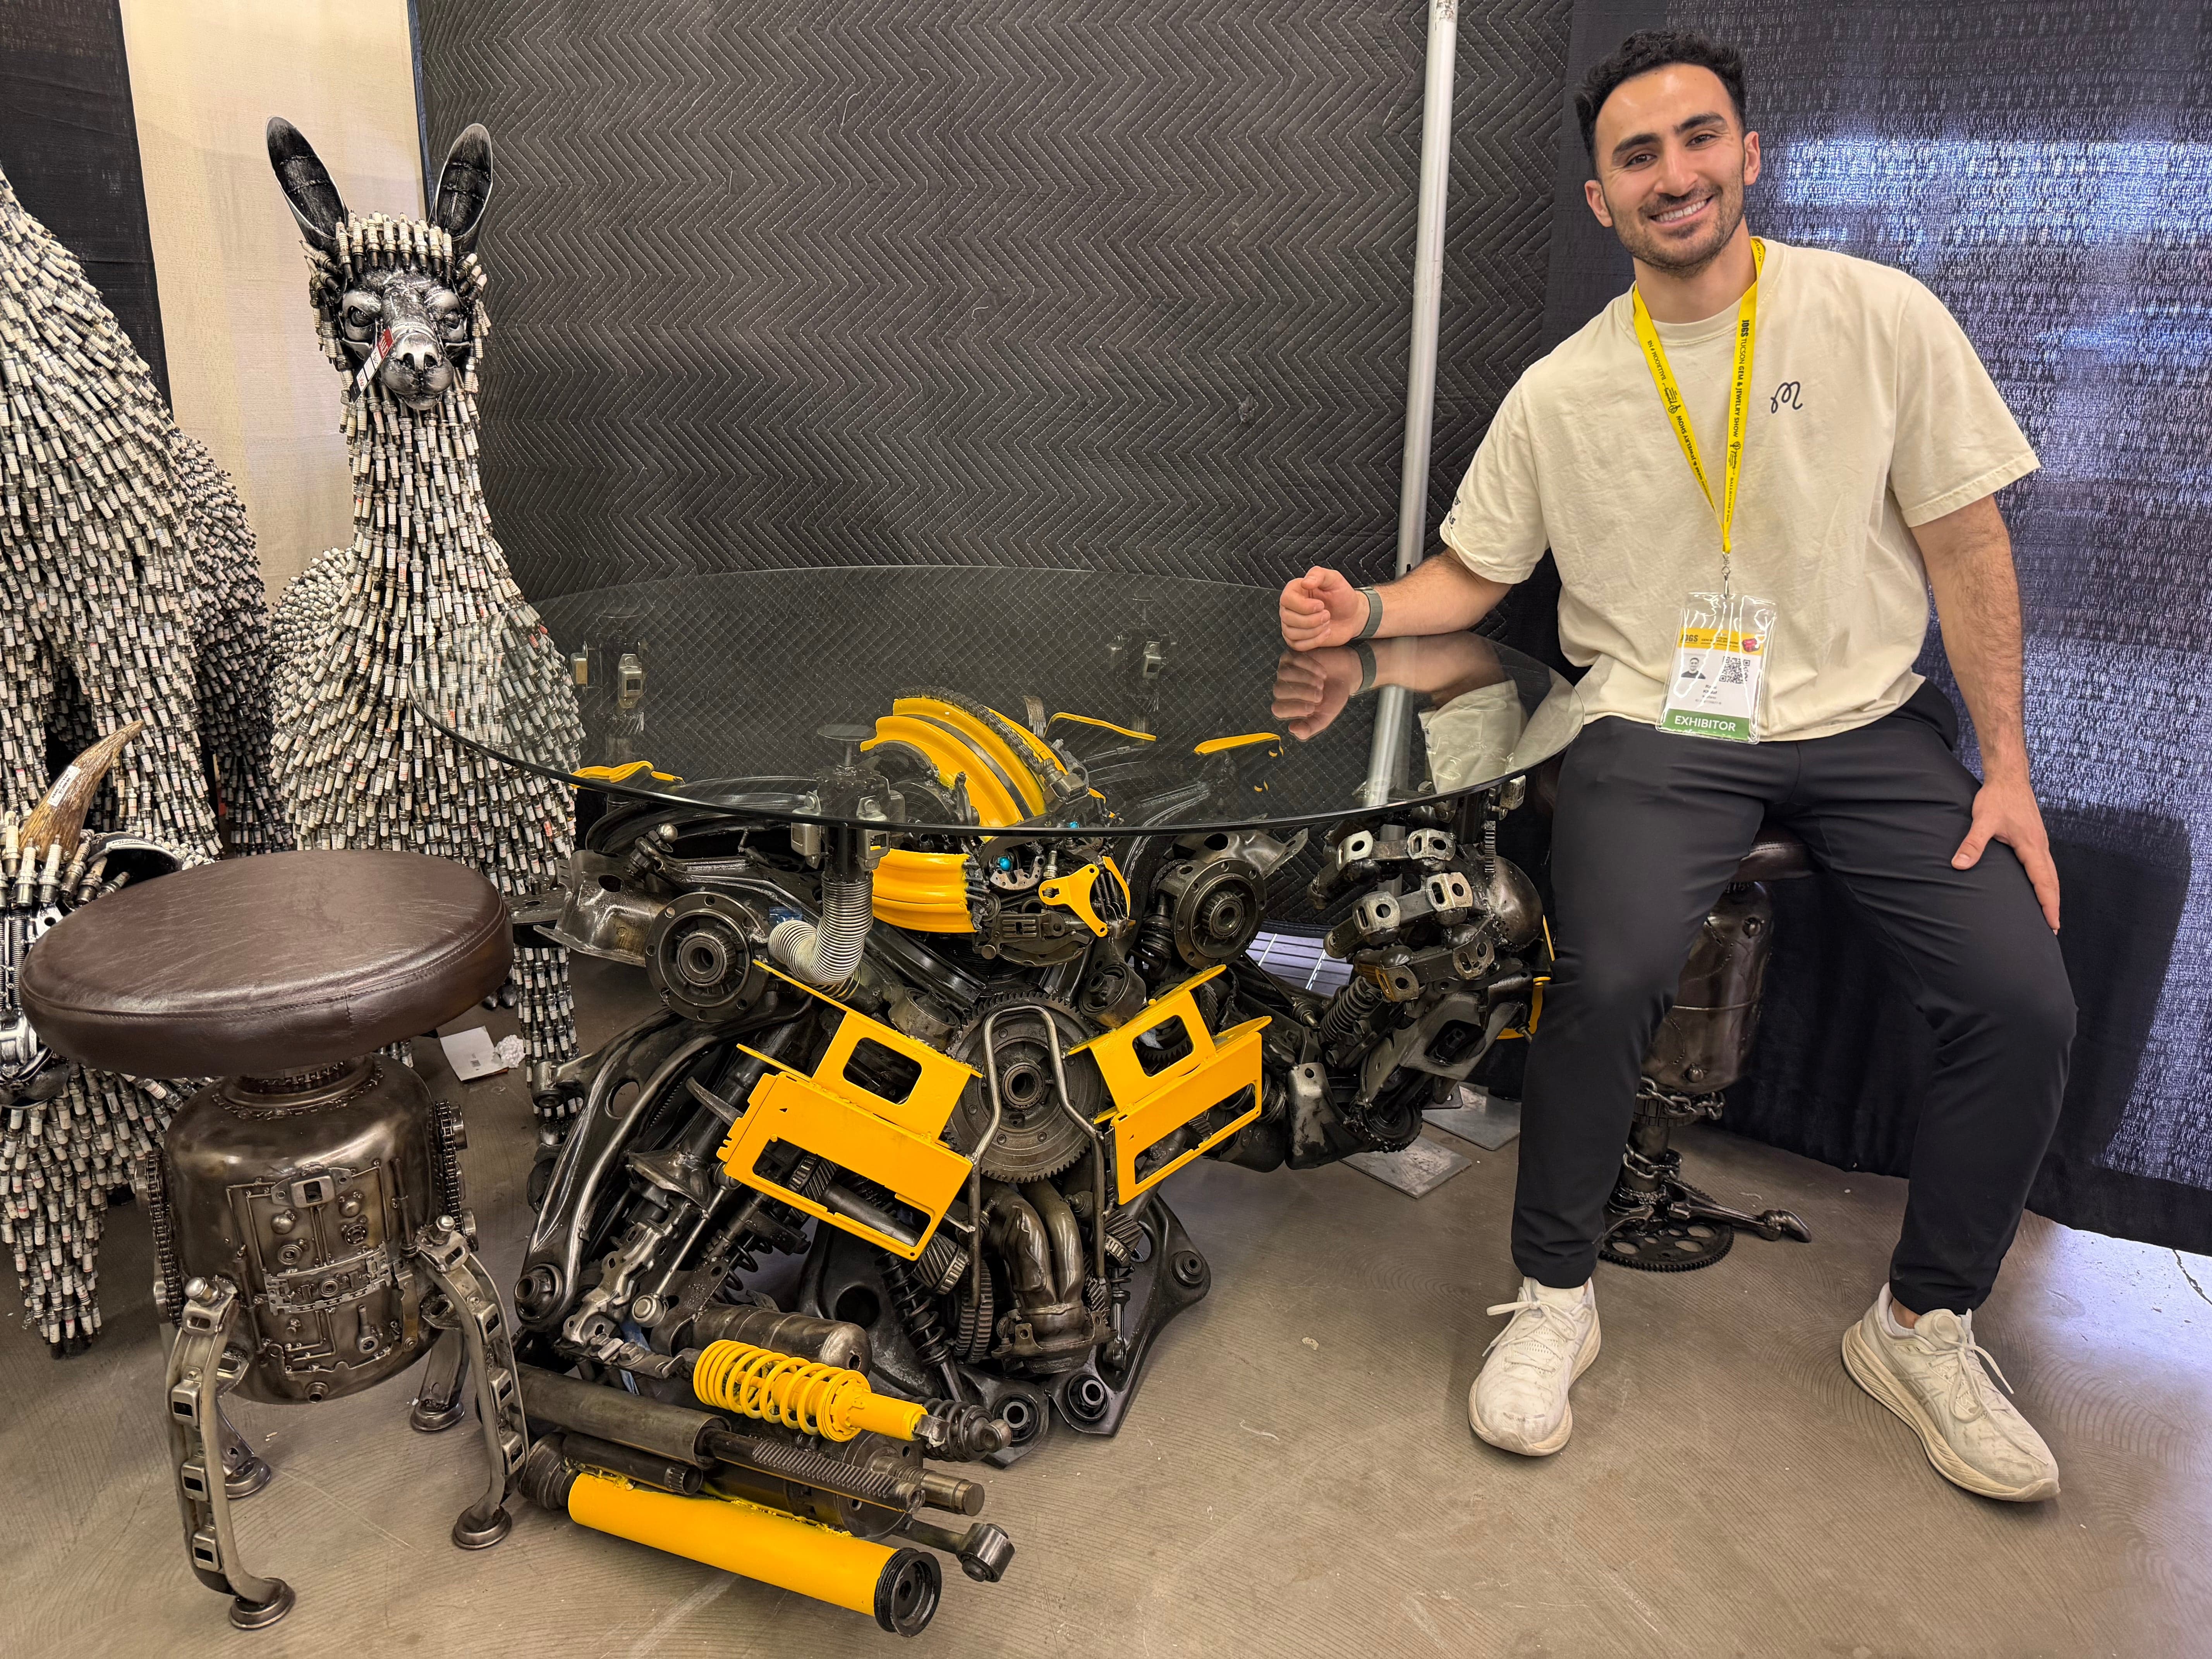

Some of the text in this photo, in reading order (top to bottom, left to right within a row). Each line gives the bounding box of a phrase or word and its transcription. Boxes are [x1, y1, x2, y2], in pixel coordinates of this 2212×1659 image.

[1741, 319, 1750, 337] JOGS
[1739, 338, 1747, 364] TUCSON
[1652, 351, 1666, 380] BALLROOM
[1676, 416, 1687, 434] SHOW
[1683, 435, 1697, 460] JEWELRY
[1674, 715, 1736, 732] EXHIBITOR
